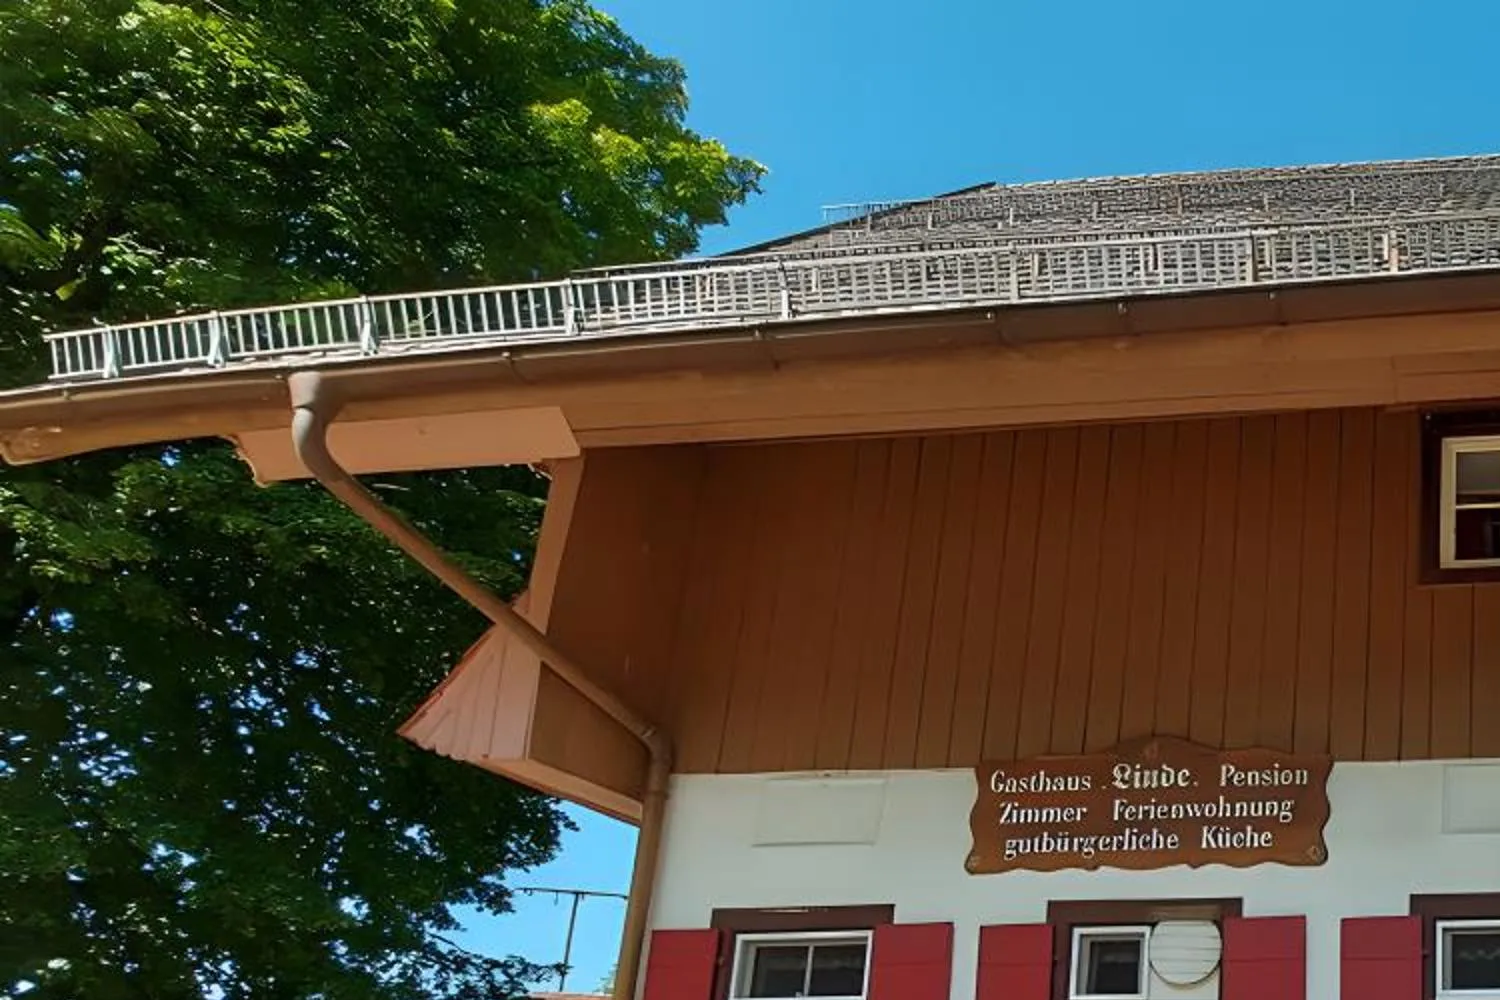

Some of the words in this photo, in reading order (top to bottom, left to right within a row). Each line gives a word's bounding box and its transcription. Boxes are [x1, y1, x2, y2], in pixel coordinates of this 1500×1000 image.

[990, 768, 1092, 793] Gasthaus
[1219, 763, 1308, 788] Pension
[999, 802, 1087, 824] Zimmer
[1112, 798, 1296, 822] Ferienwohnung
[1003, 827, 1180, 860] gutbürgerliche
[1200, 826, 1274, 850] Küche
